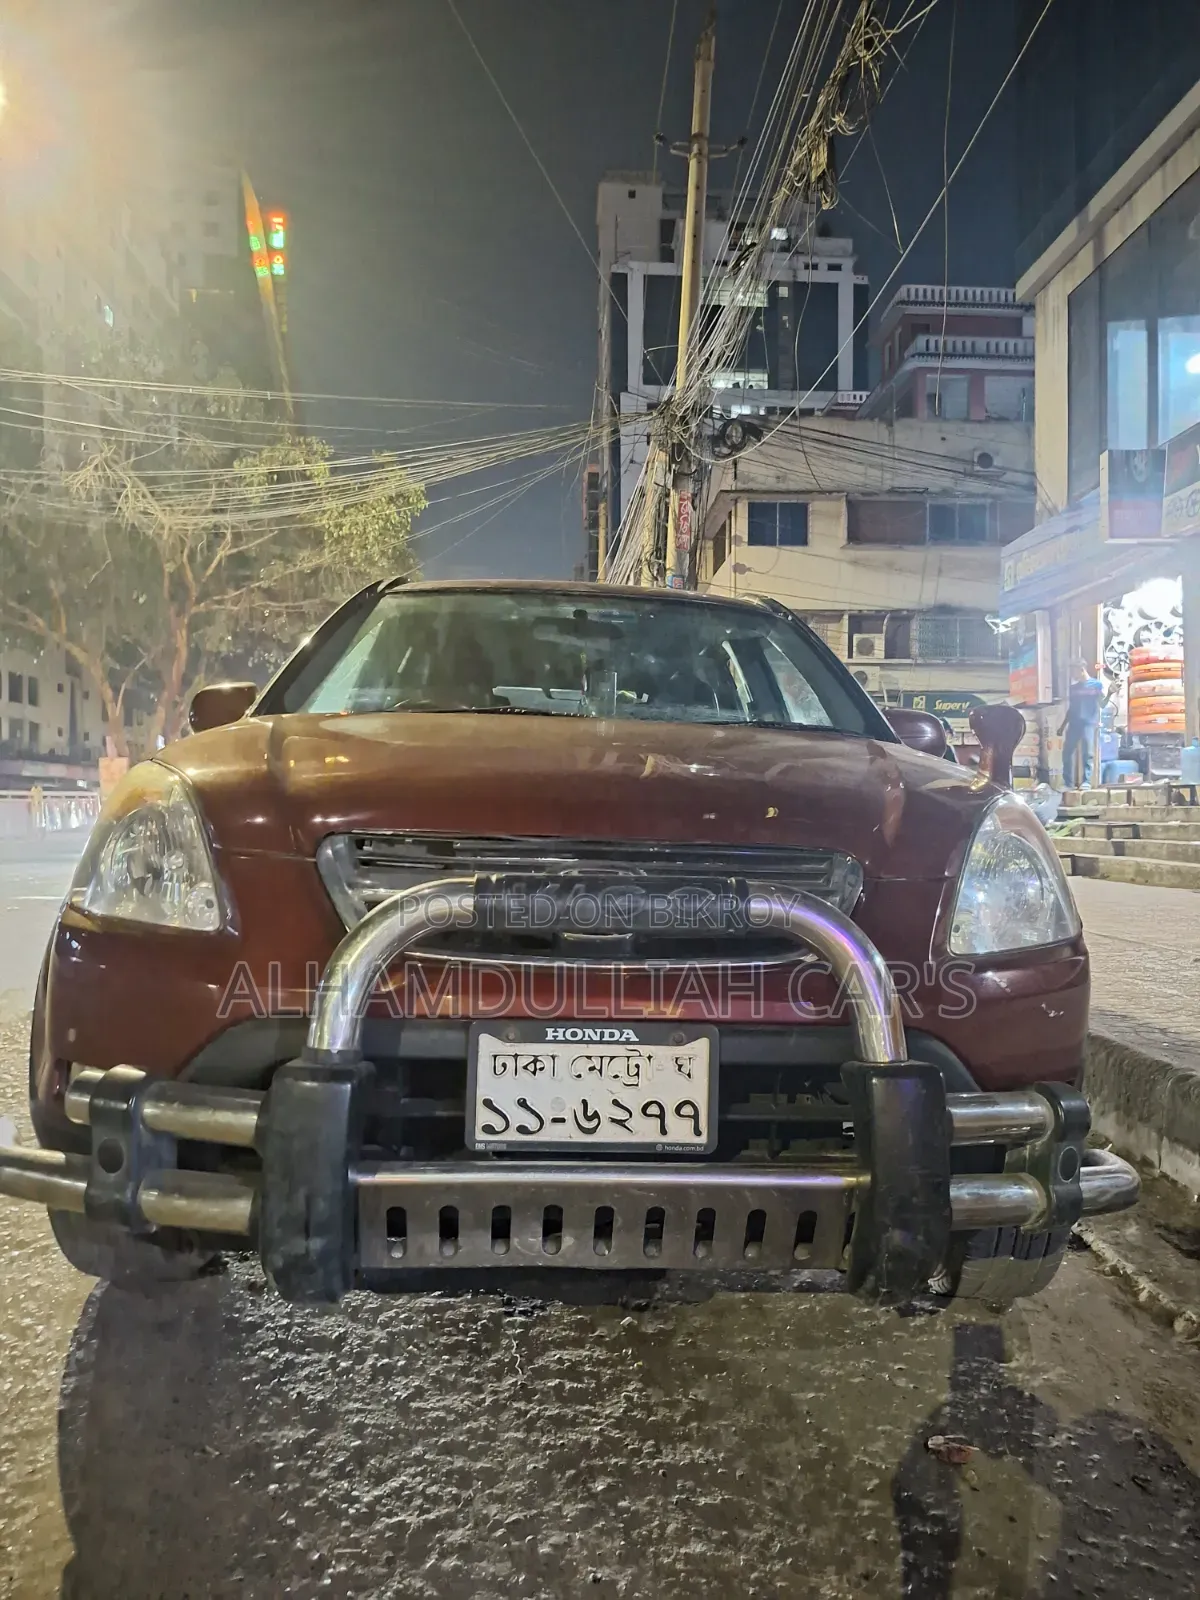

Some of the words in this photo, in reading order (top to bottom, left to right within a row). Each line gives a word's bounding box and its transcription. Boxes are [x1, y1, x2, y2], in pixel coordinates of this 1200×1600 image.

[545, 1028, 639, 1042] HONDA
[491, 1053, 559, 1079] ঢাকা
[481, 1097, 703, 1137] ১১-৬২৭৭
